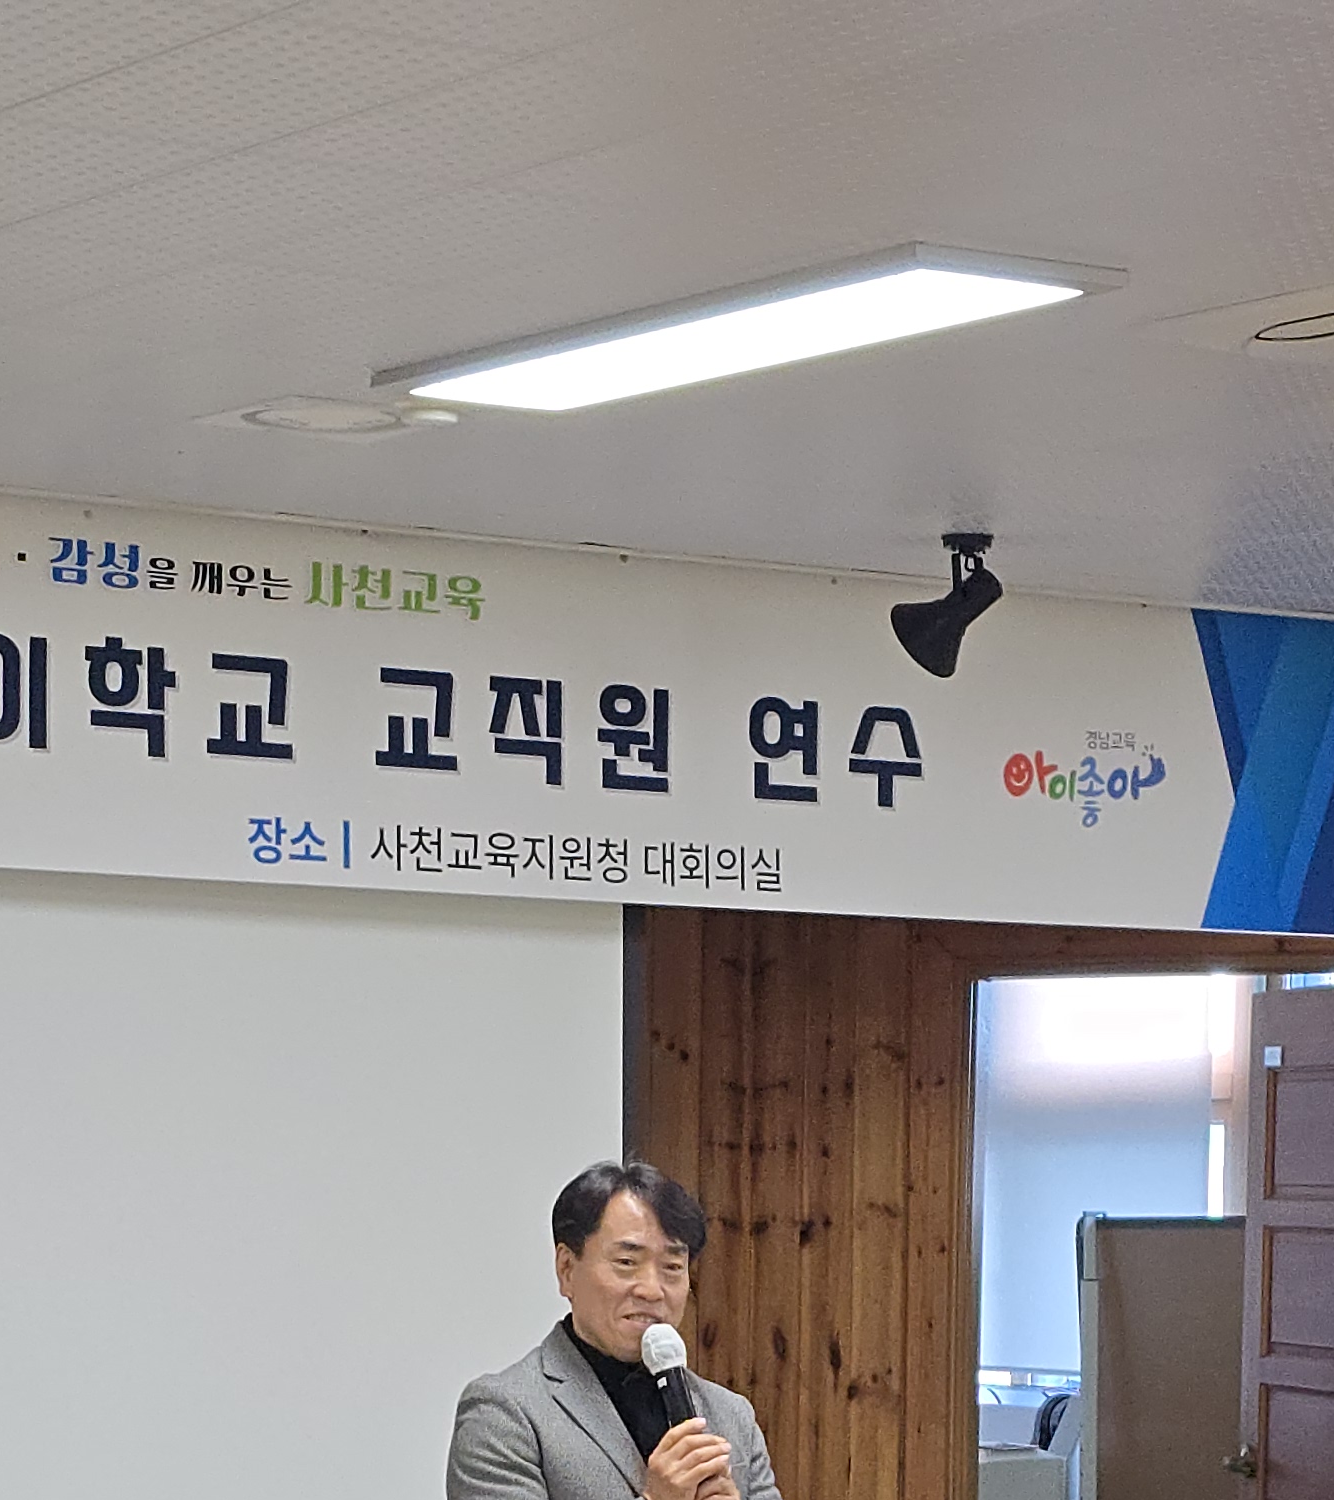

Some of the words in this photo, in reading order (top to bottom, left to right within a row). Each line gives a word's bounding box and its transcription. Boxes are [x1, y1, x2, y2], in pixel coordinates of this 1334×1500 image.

[48, 537, 178, 590] 감성을
[191, 560, 293, 600] 깨우는
[304, 560, 486, 620] 사천교육
[375, 666, 671, 795] 교직원
[748, 695, 924, 808] 연수
[1085, 730, 1136, 751] 경남교육
[1003, 750, 1166, 828] 아이좋아
[247, 817, 328, 866] 장소
[370, 824, 630, 884] 사천교육지원청
[644, 841, 784, 892] 대회의실
